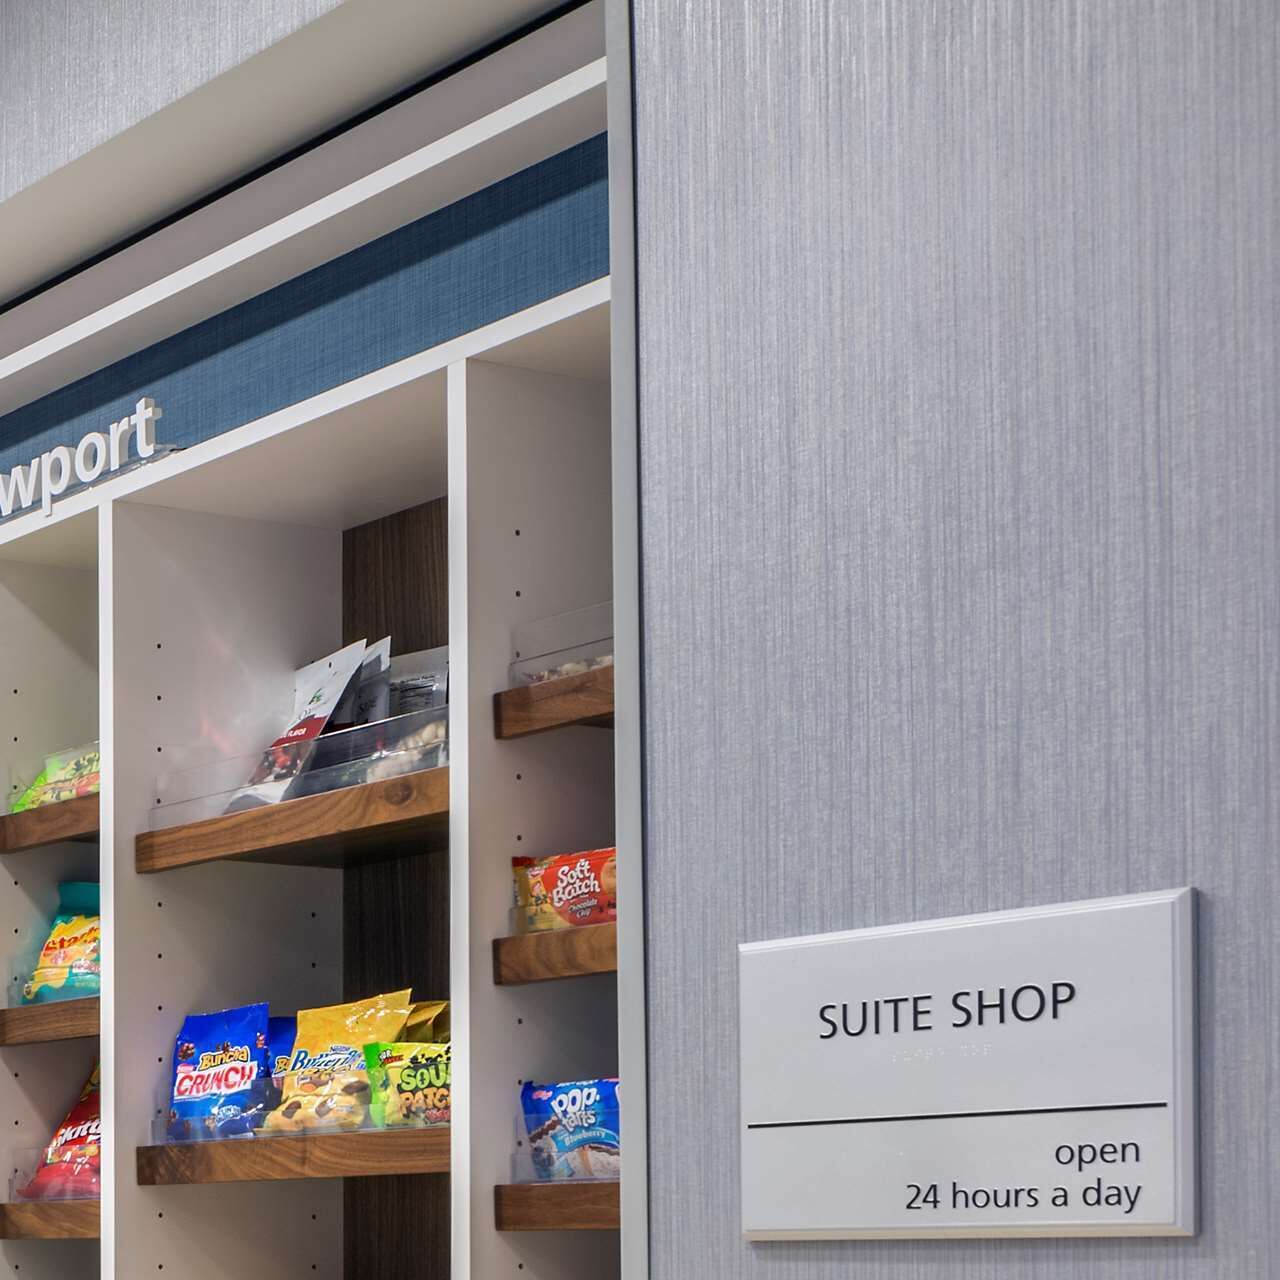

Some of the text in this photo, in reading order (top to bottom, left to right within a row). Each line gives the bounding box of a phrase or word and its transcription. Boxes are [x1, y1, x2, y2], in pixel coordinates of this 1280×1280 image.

[557, 858, 591, 887] Soft
[553, 873, 600, 907] Batch
[819, 981, 1077, 1040] SUITE SHOP
[176, 1064, 255, 1096] CRUNCH
[400, 1063, 451, 1091] SOU
[1055, 1140, 1141, 1171] open
[905, 1178, 1142, 1213] 24 hours a day
